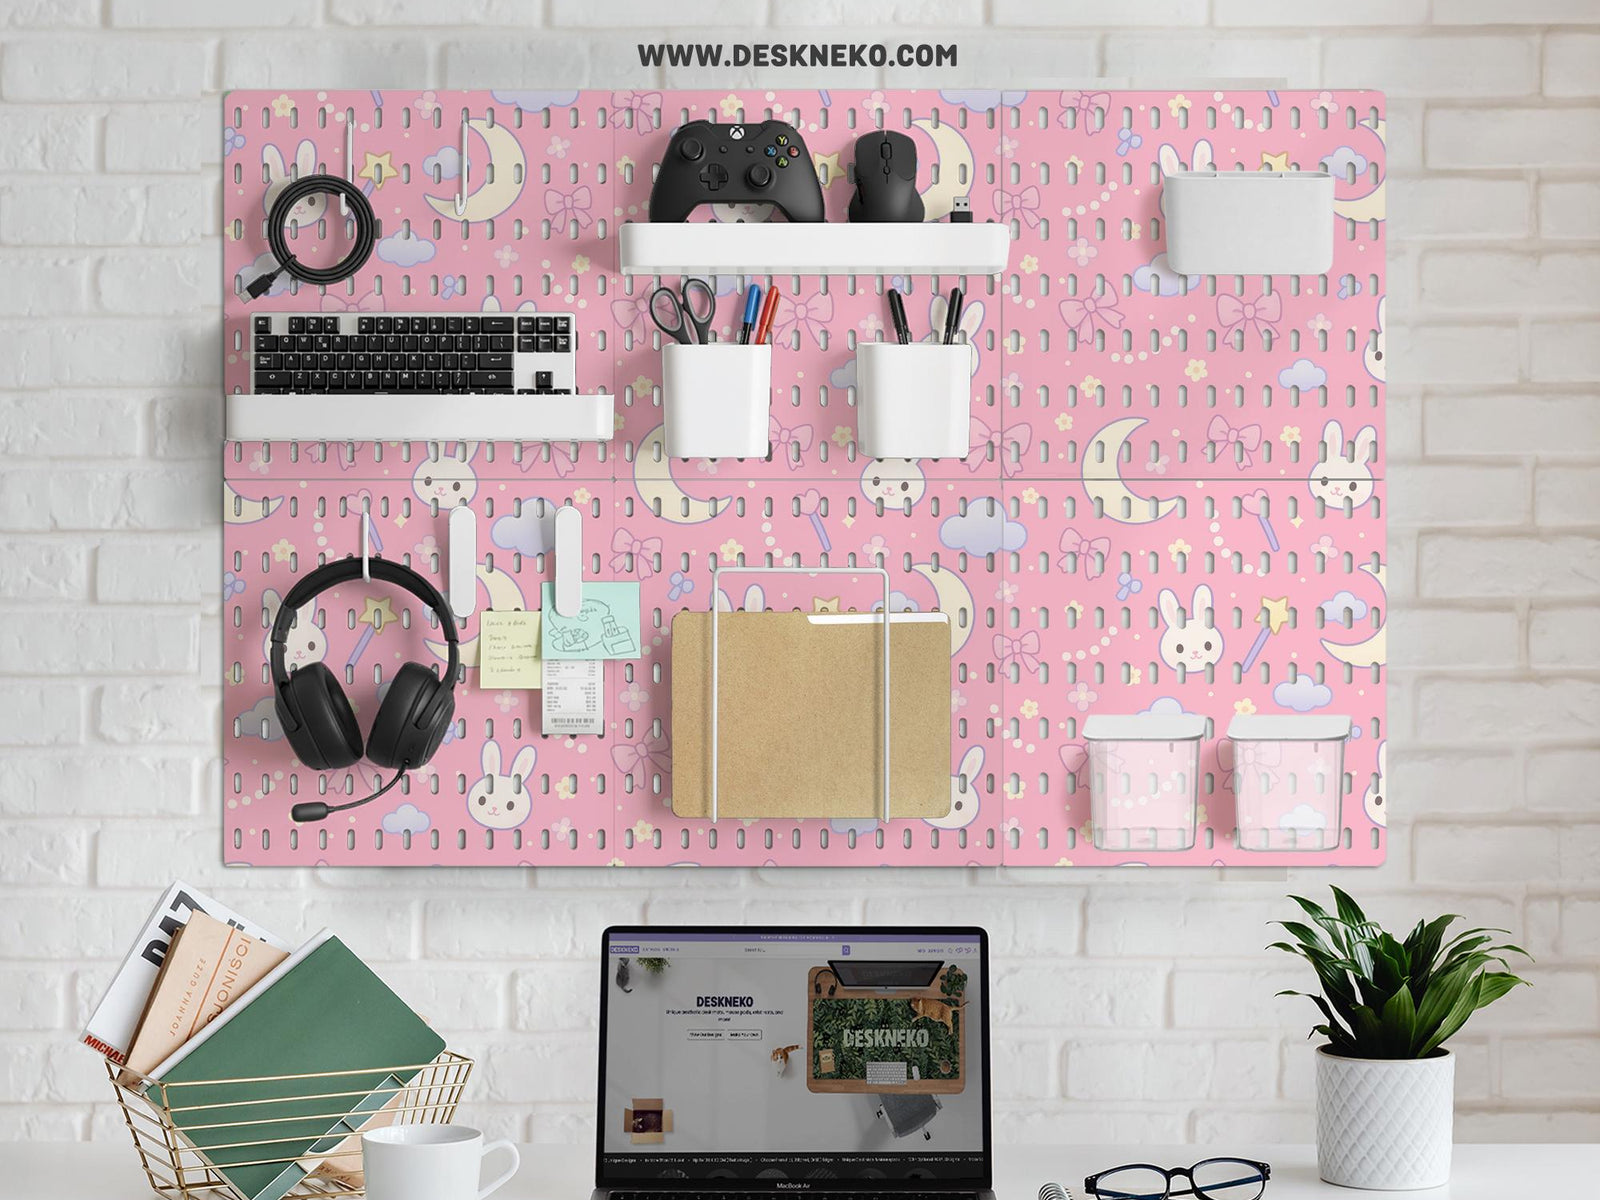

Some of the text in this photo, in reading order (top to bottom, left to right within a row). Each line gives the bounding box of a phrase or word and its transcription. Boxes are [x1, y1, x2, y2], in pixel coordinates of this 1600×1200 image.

[778, 136, 785, 145] Y
[768, 146, 774, 155] X
[778, 157, 786, 166] A
[696, 996, 754, 1007] DESKNEKO
[170, 991, 193, 1037] JOANNA
[843, 1028, 929, 1048] DESKNEKO
